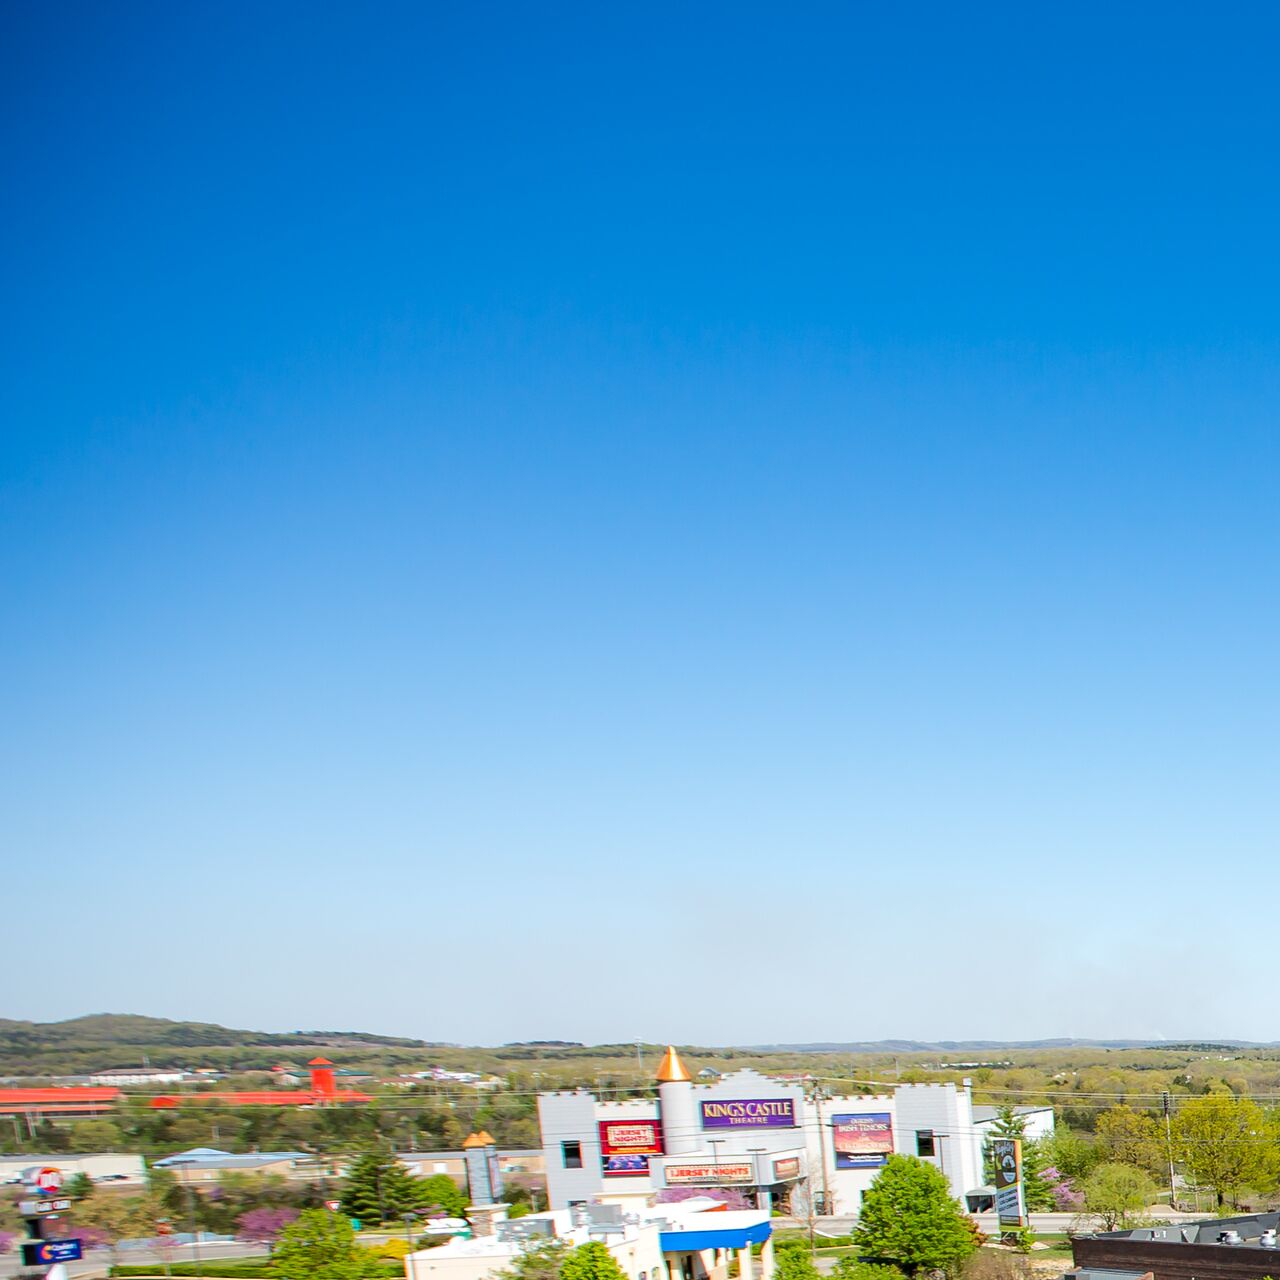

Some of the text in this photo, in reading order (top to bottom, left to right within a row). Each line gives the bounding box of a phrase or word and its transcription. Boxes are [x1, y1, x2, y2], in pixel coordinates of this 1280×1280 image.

[703, 1102, 791, 1117] KING'S CASTLE
[675, 1168, 709, 1177] JERSEY
[712, 1167, 749, 1175] NIGHTS
